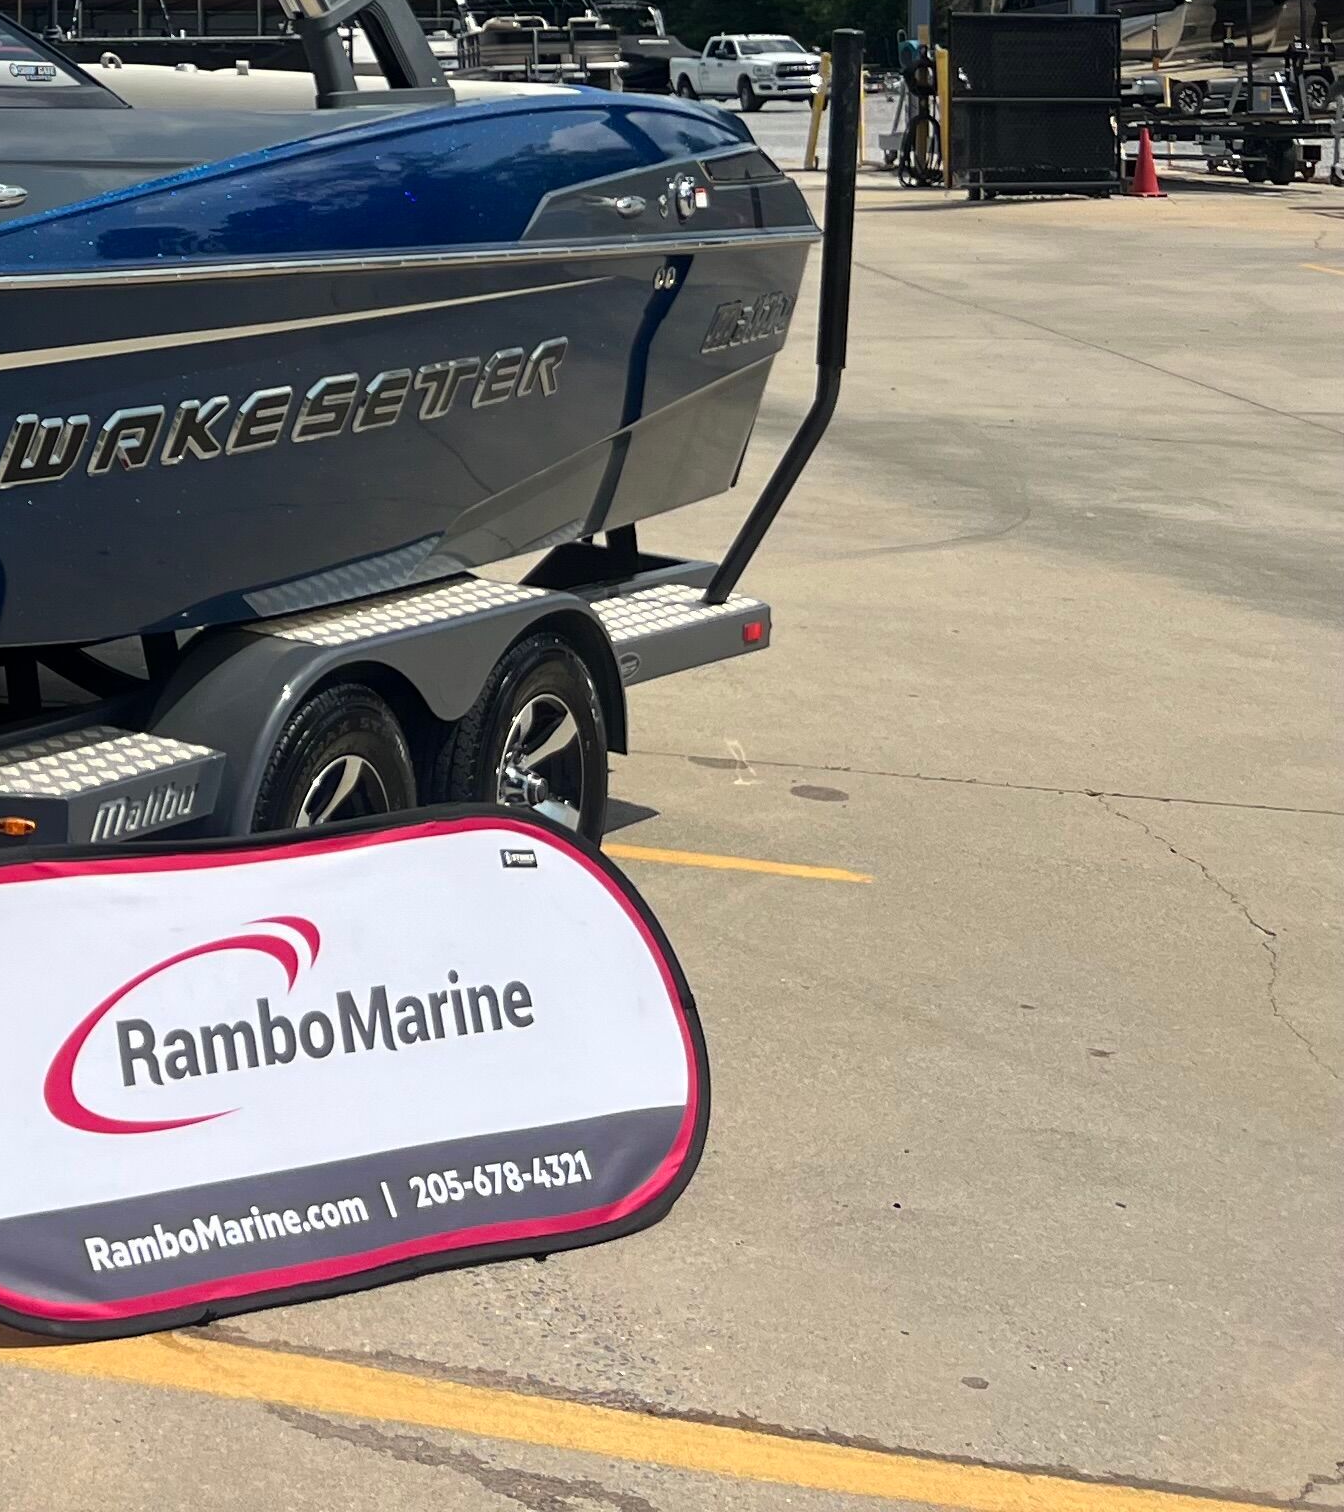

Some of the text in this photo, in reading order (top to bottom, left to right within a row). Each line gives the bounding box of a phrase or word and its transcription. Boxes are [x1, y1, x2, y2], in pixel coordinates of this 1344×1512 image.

[90, 782, 199, 844] Malibu
[115, 969, 535, 1088] RamboMarine
[84, 1193, 370, 1271] RamboMarine.com
[408, 1148, 593, 1209] 205-678-4321
